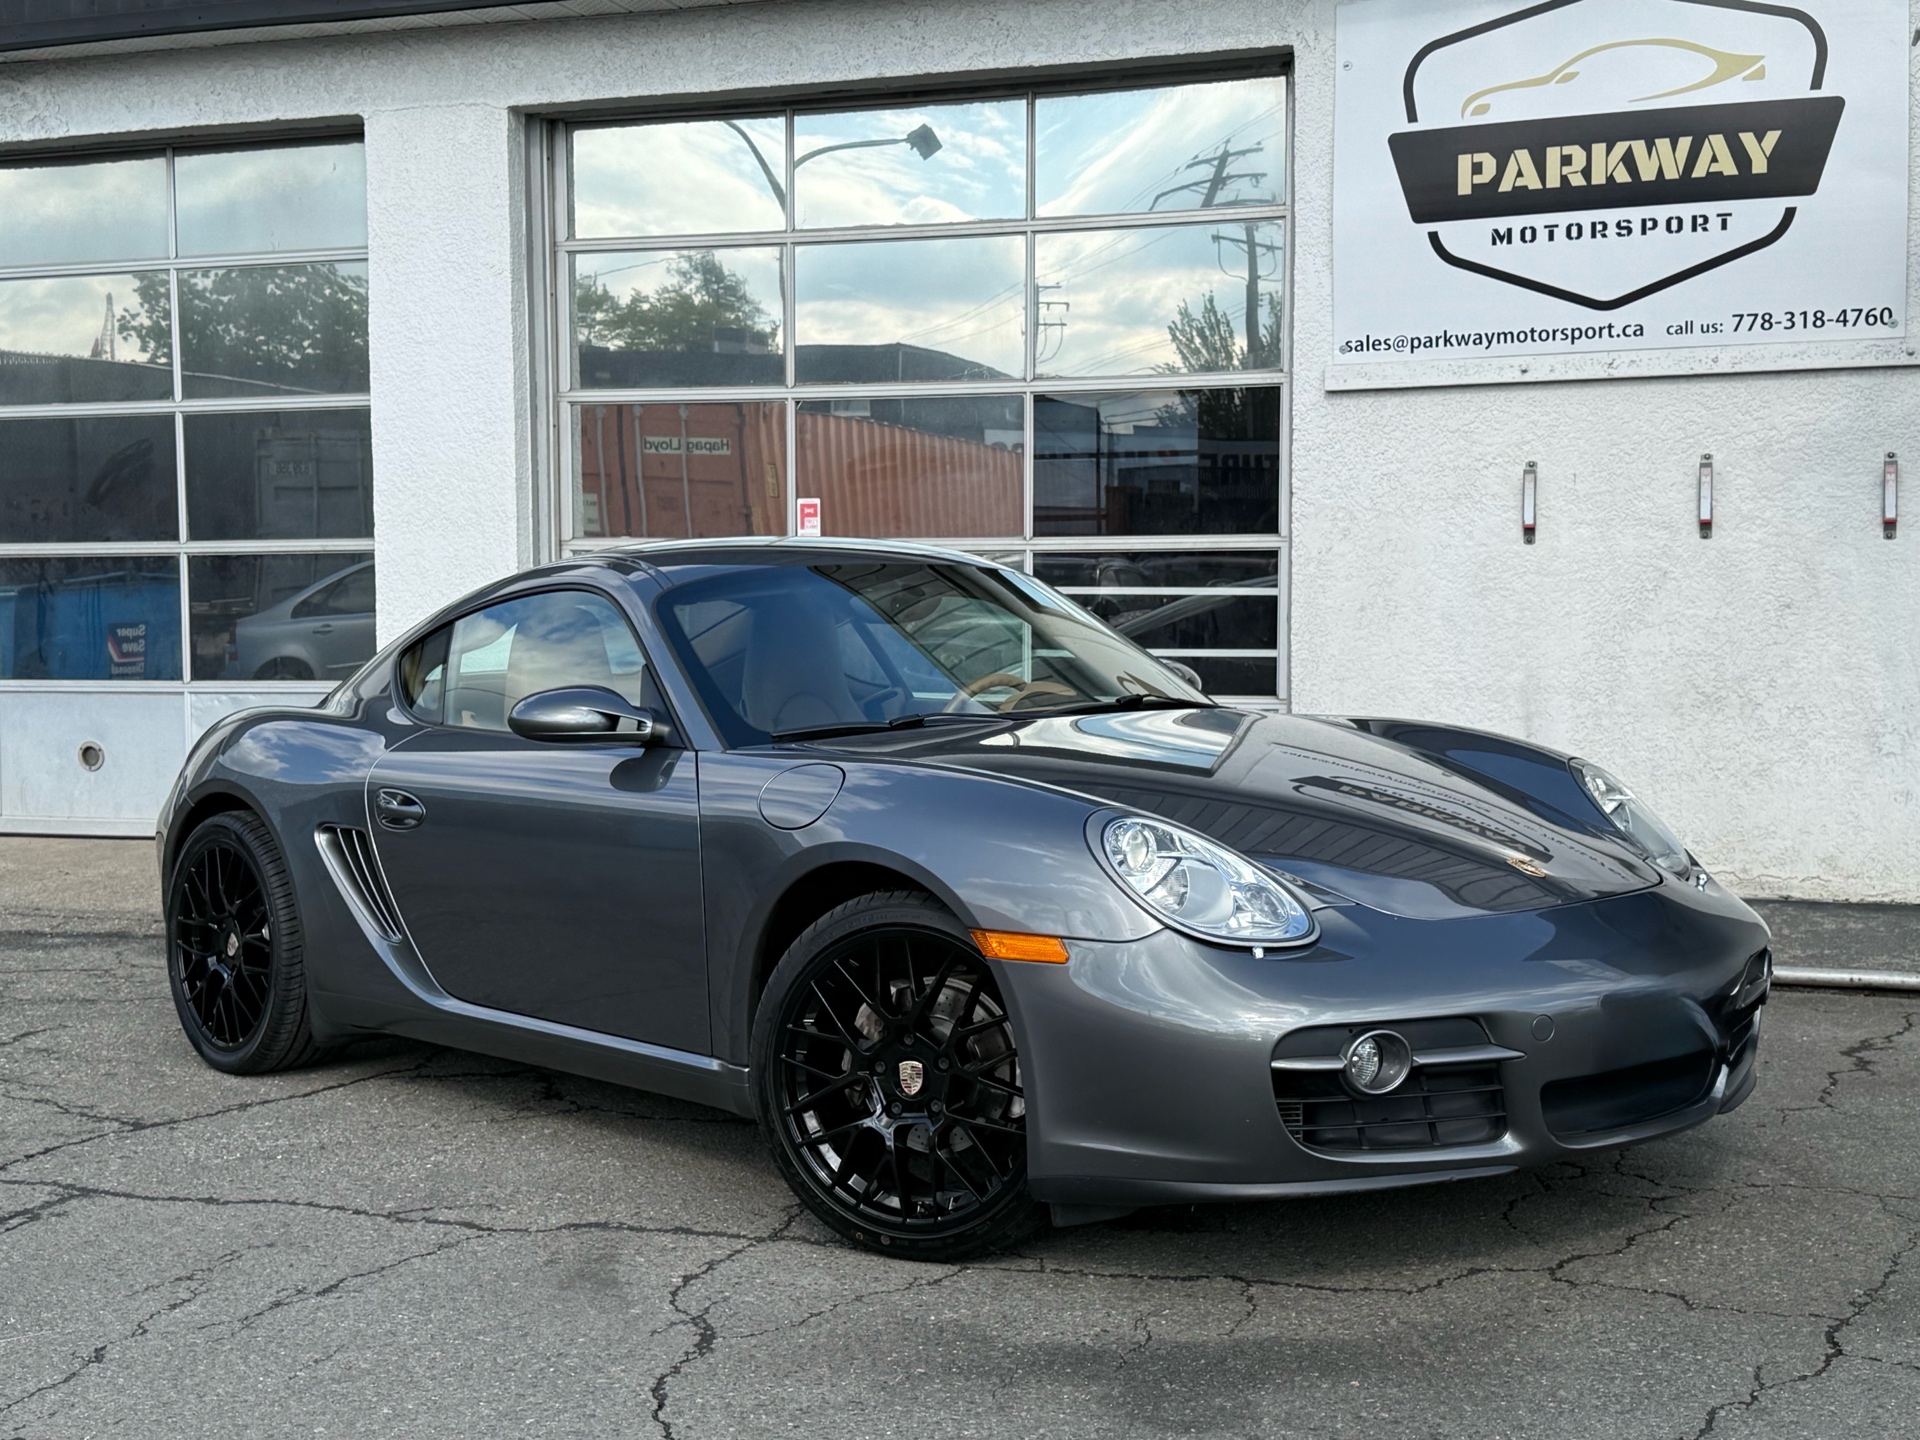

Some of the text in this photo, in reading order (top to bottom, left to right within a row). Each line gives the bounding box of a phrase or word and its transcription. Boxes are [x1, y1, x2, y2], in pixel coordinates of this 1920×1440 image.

[1457, 130, 1783, 196] PARKWAY
[1491, 212, 1733, 246] MOTORSPORT
[1345, 320, 1645, 354] sales@parkwaymotorsport.ca
[1666, 306, 1893, 336] call us: 778-318-4760
